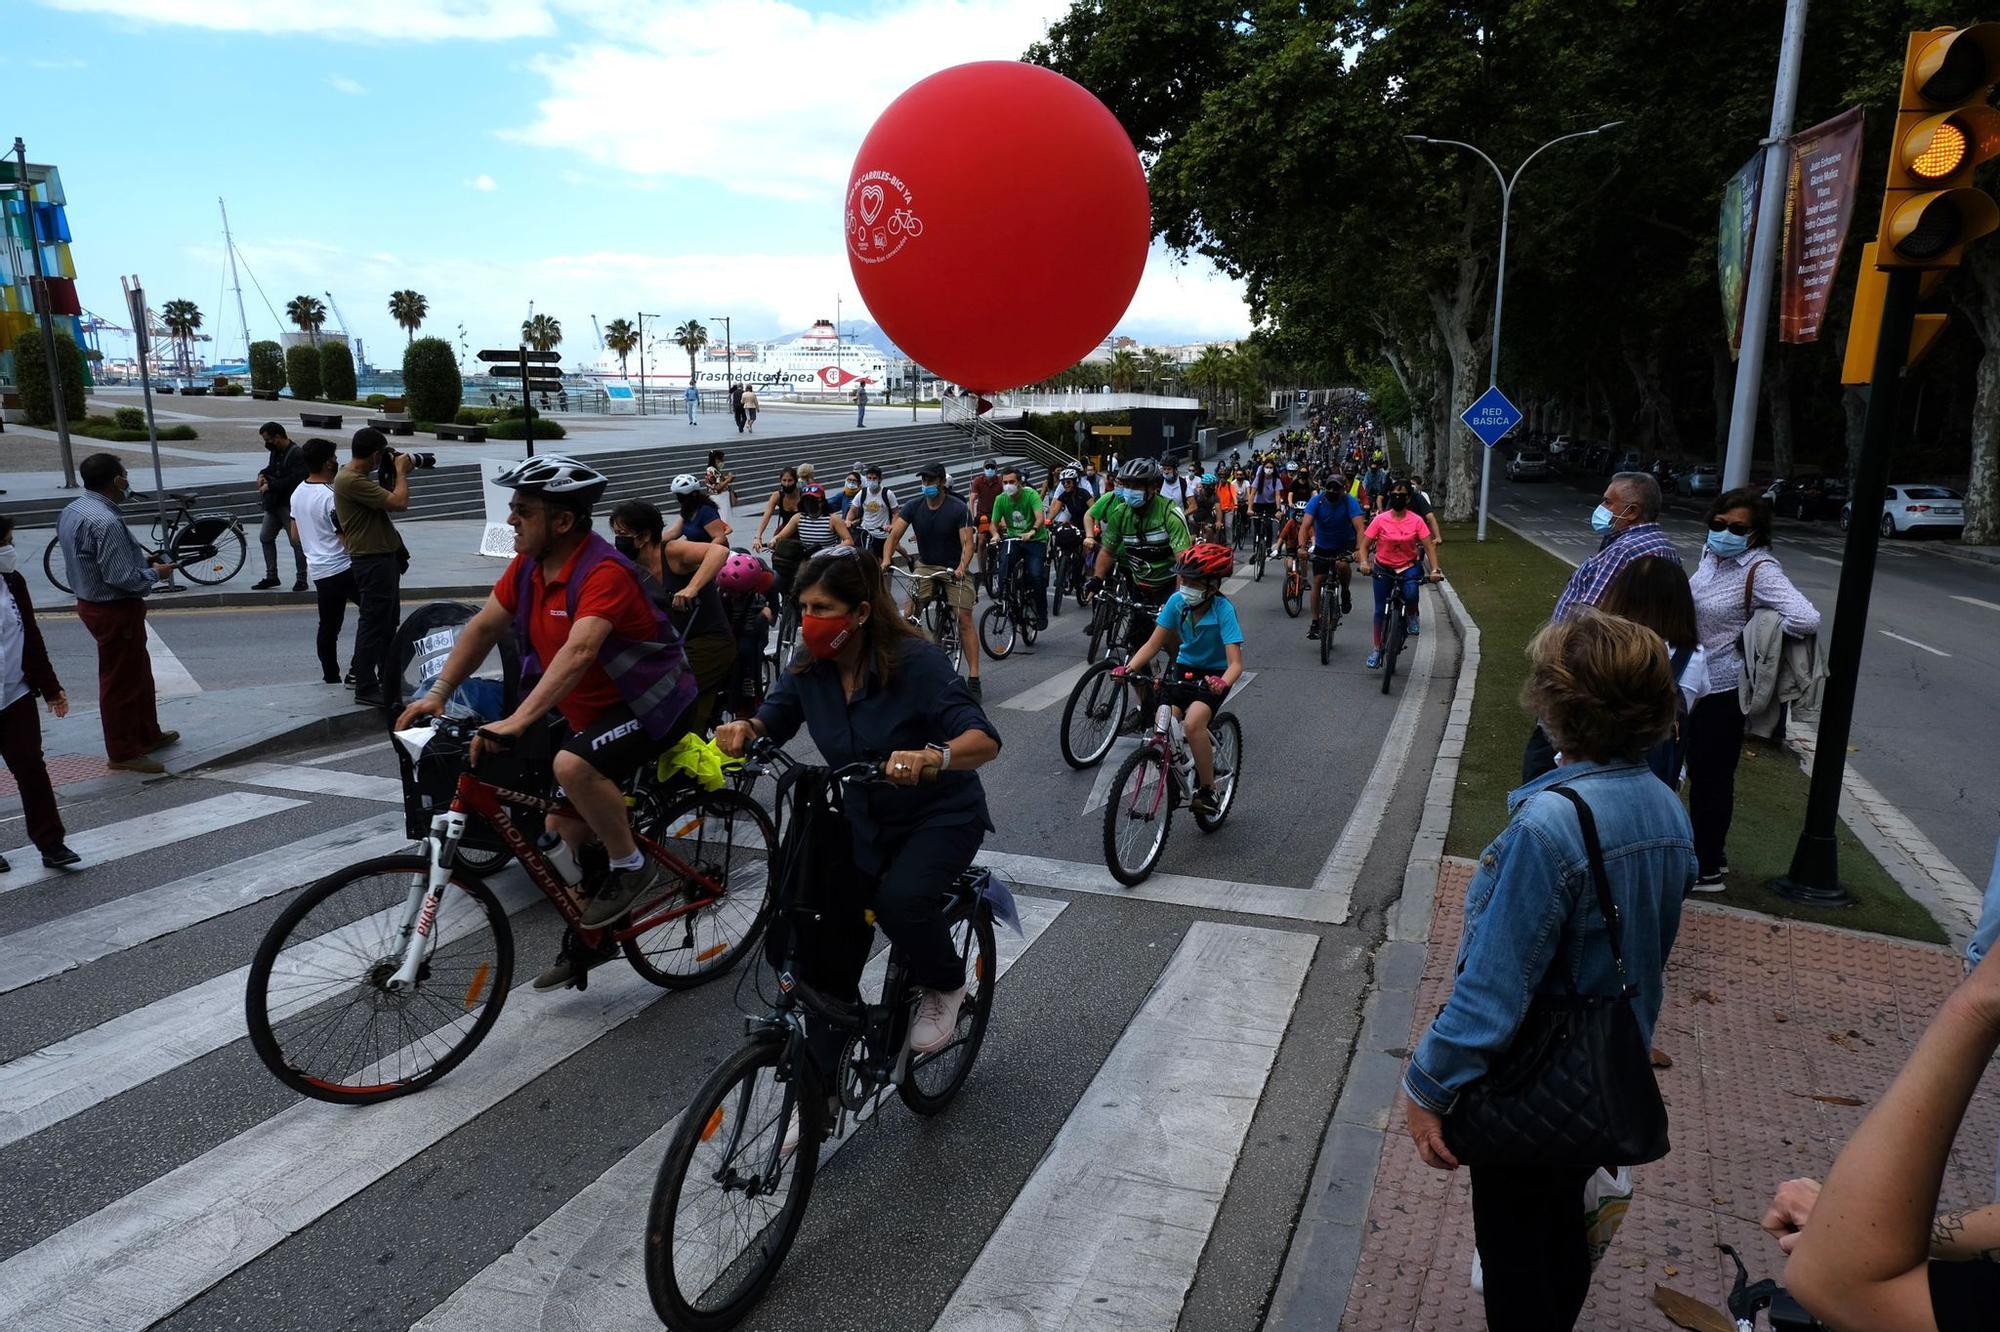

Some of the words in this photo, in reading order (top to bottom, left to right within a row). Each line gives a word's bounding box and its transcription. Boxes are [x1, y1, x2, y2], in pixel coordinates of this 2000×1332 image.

[694, 369, 815, 384] Trasmediteránea
[1482, 407, 1503, 416] RED
[1473, 417, 1510, 425] BASICA
